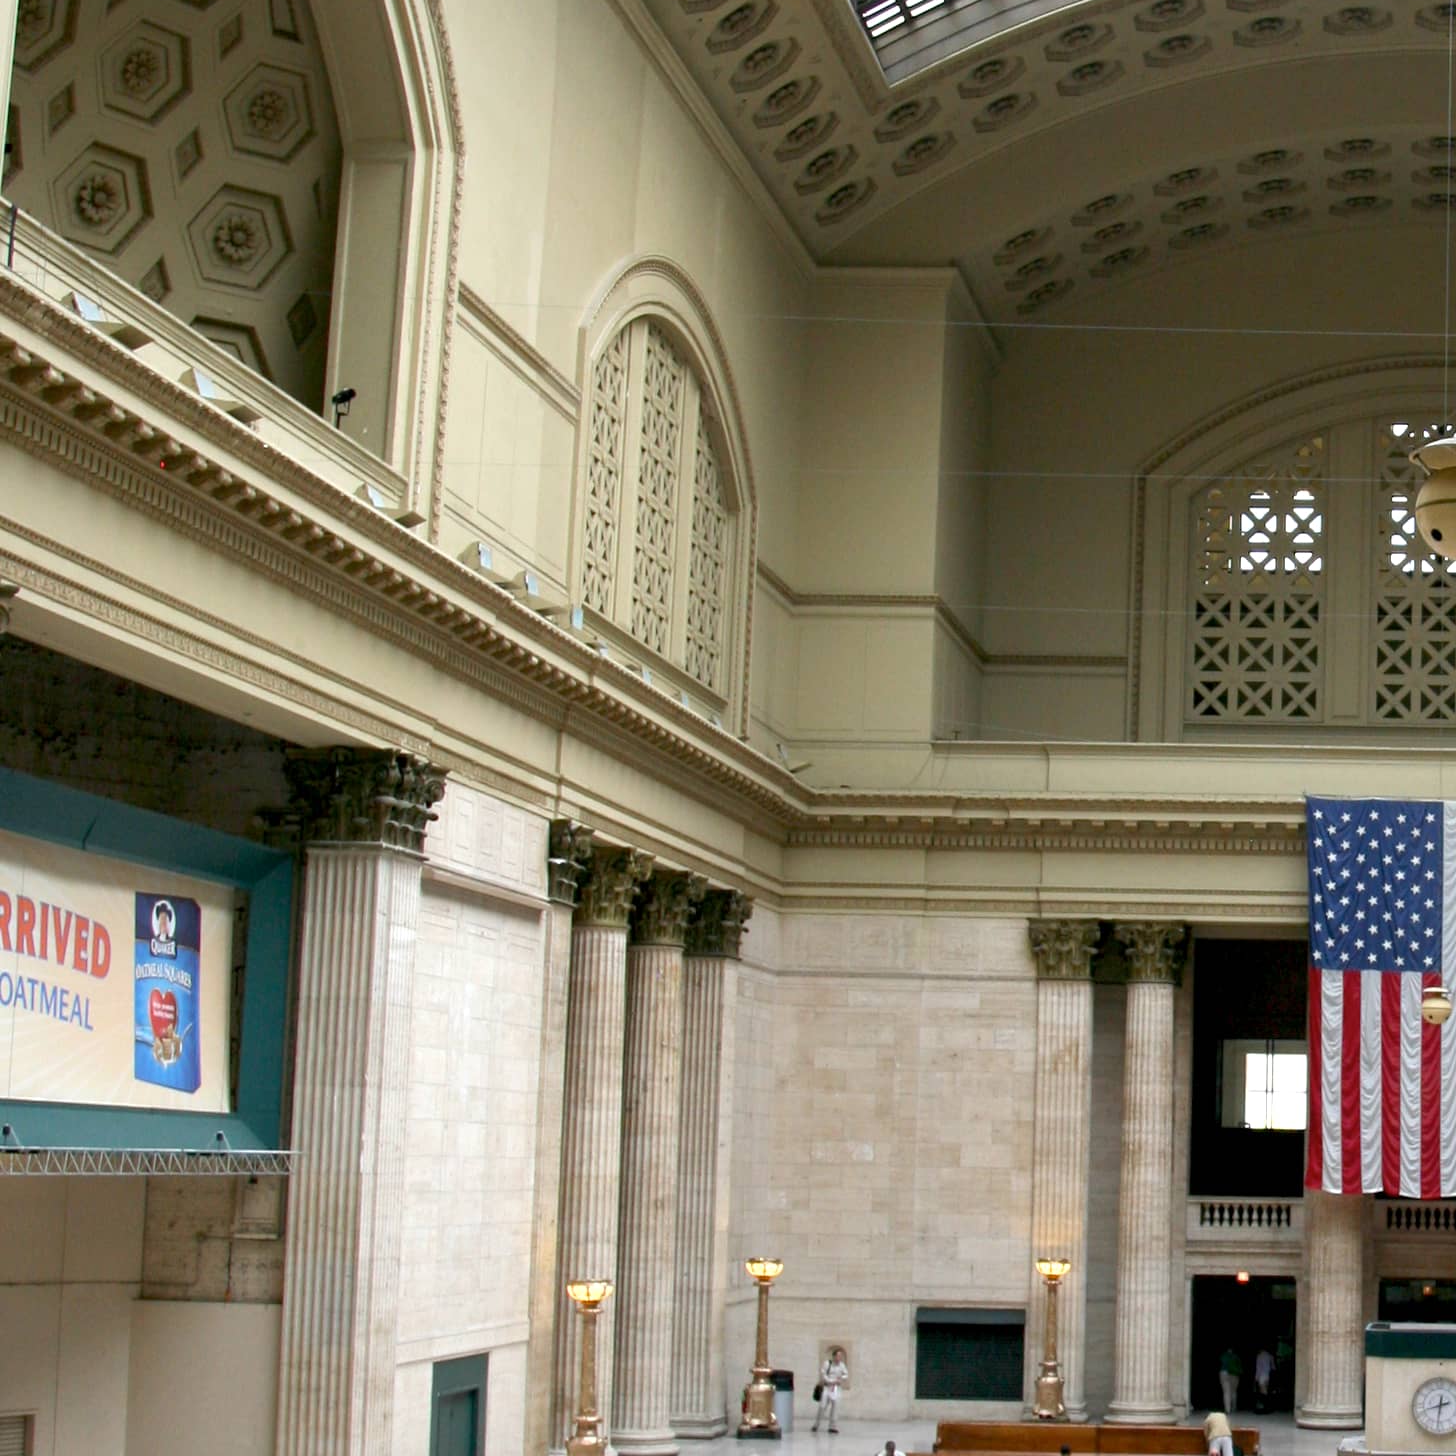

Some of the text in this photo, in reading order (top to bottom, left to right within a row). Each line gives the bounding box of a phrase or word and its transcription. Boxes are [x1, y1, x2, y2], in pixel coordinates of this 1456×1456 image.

[150, 938, 177, 956] QUAKER
[135, 962, 164, 980] OATMEAL
[0, 971, 94, 1032] OATMEAL
